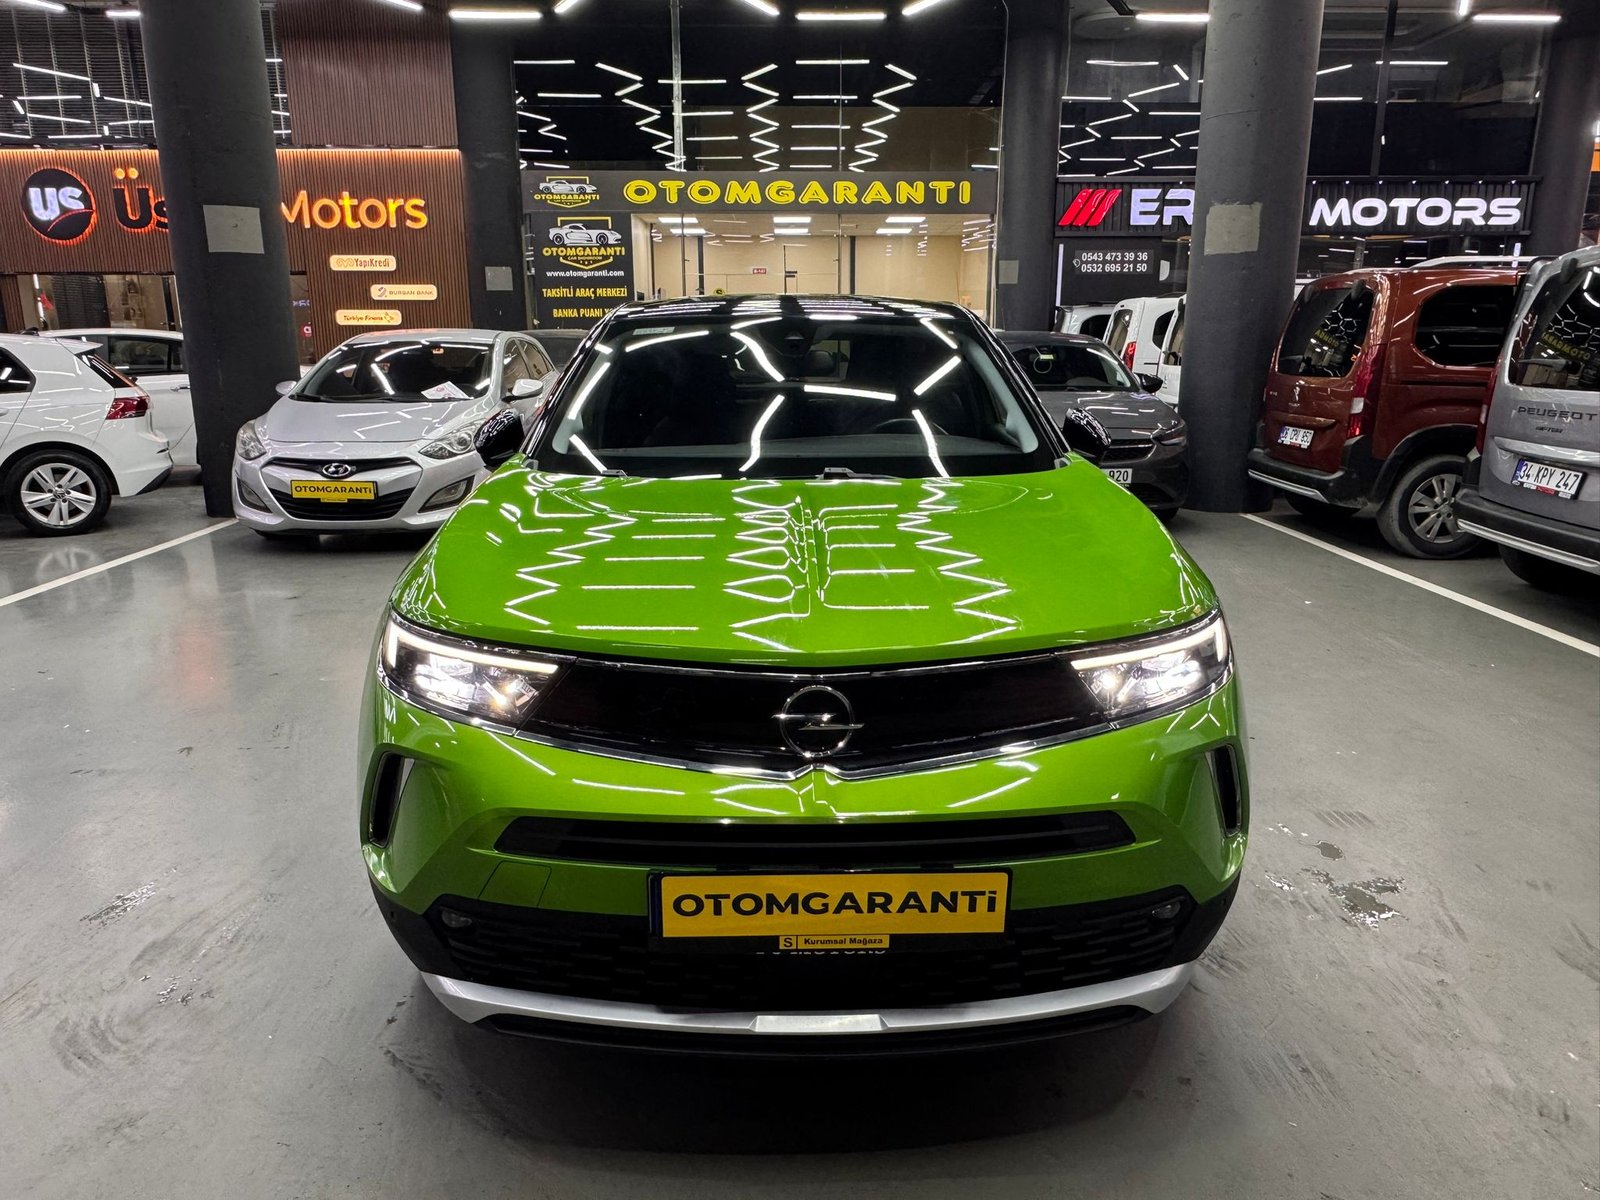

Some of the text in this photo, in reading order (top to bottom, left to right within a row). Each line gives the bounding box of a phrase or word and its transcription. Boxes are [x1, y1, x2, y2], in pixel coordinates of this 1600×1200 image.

[623, 179, 971, 204] OTOMGARANTI
[281, 190, 428, 229] Motors
[1308, 197, 1522, 227] MOTORS
[542, 246, 625, 256] OTOMGARANTI
[1081, 252, 1148, 261] 0543 473 39 36
[546, 269, 625, 278] www.otomgaranti.com
[1081, 263, 1148, 272] 0532 695 21 50
[542, 285, 628, 299] TAKSİTLİ ARAÇ MERKEZİ
[553, 308, 578, 317] BANKA
[580, 308, 602, 317] PUANI
[1517, 406, 1598, 421] PEUGEOT
[1519, 462, 1533, 480] 34
[1534, 466, 1556, 486] KPY
[1555, 470, 1580, 491] 247
[783, 937, 883, 948] S Kurumsal Mağaza
